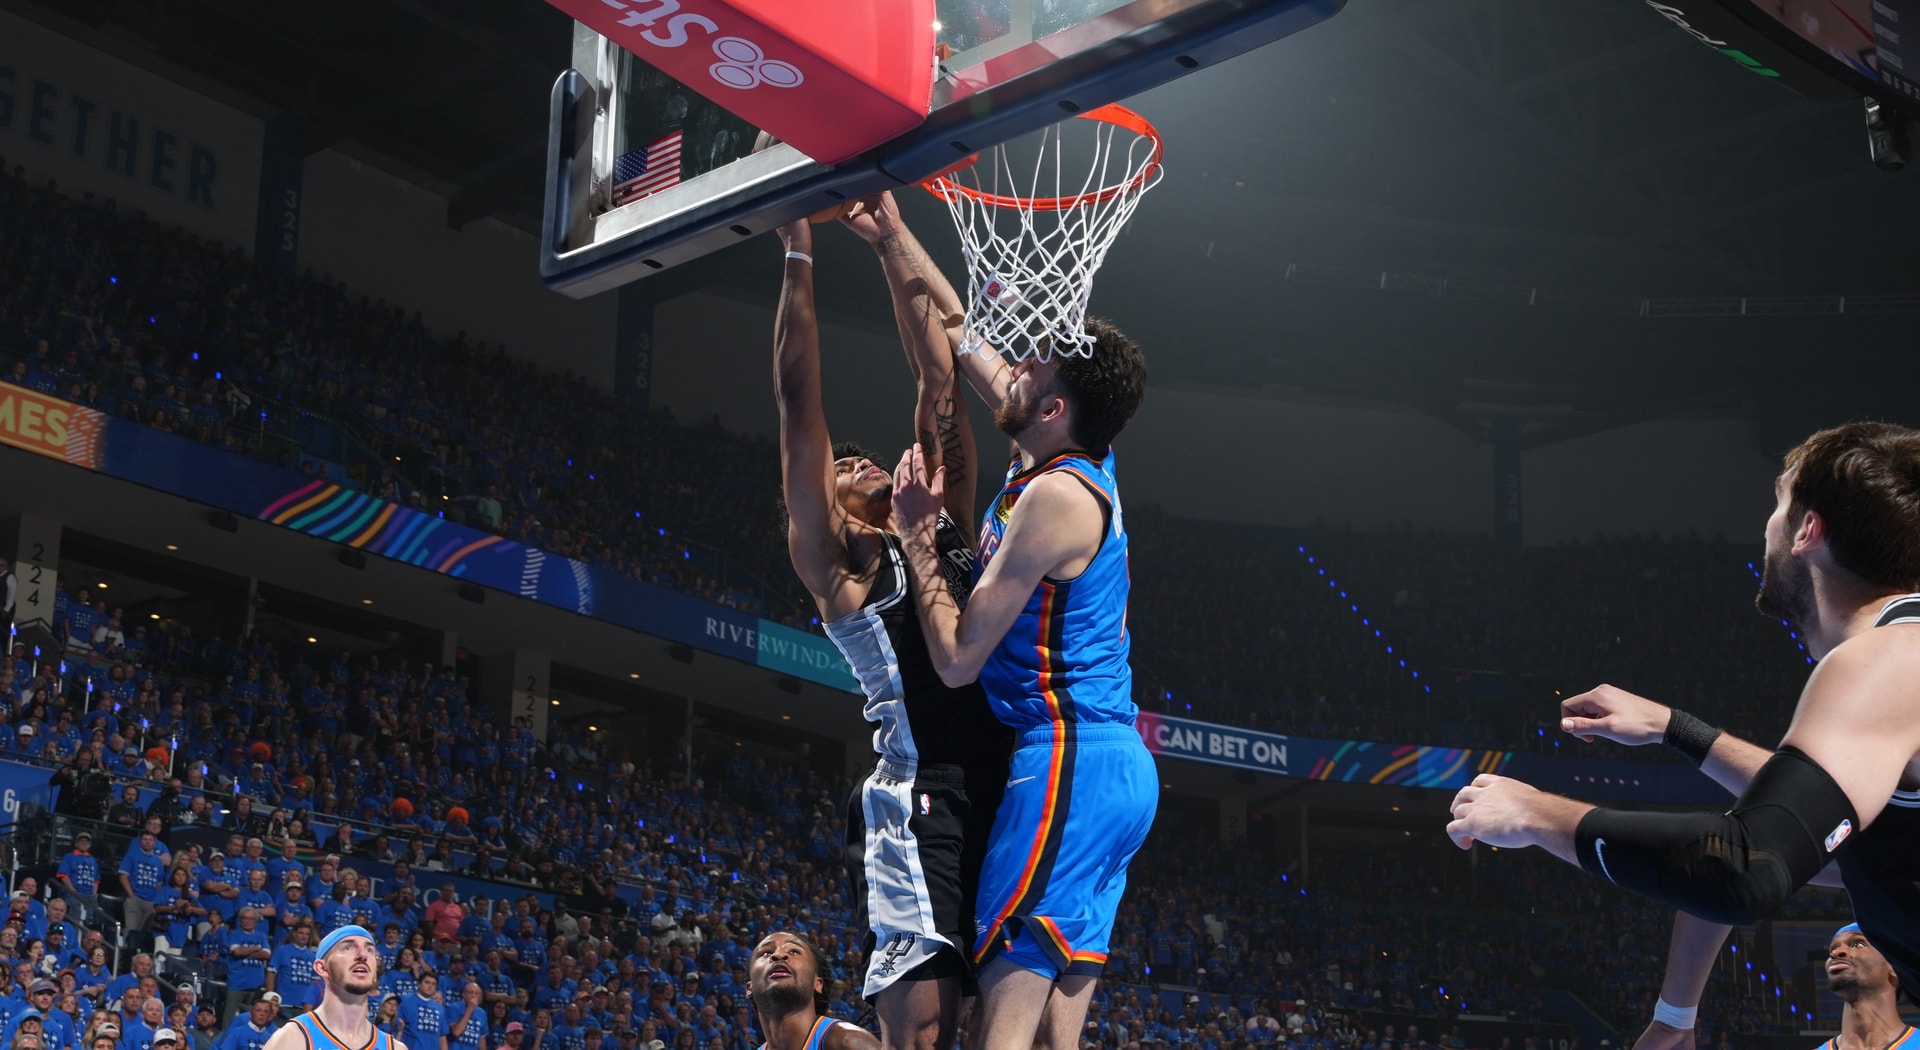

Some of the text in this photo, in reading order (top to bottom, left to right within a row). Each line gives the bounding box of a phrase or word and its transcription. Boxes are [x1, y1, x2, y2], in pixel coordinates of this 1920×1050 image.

[281, 189, 297, 251] 325
[27, 543, 45, 606] 224
[704, 616, 831, 670] RIVERWIND
[1154, 724, 1203, 753] CAN
[1208, 732, 1248, 760] BET
[1251, 740, 1288, 767] ON
[3, 788, 16, 813] 6
